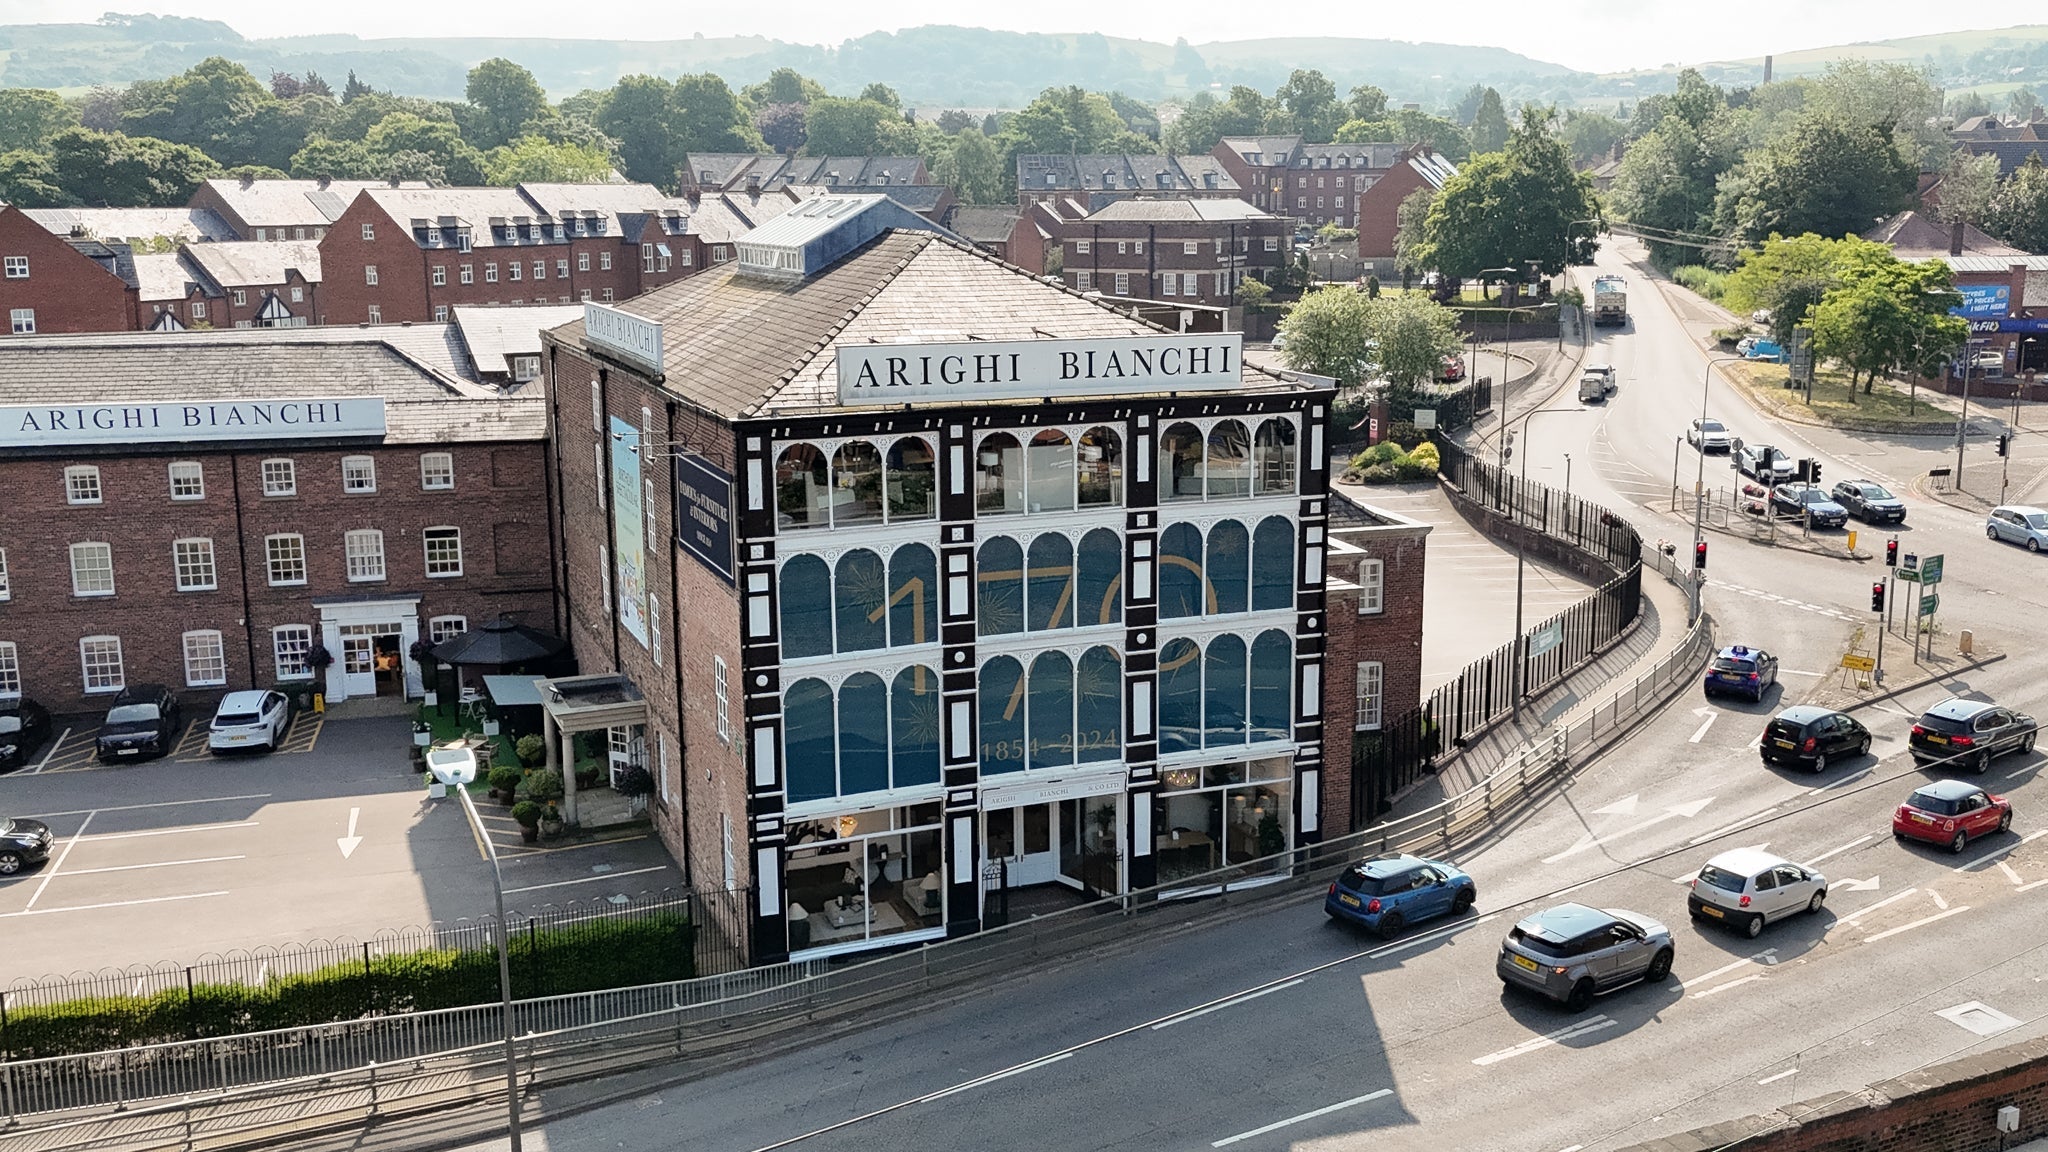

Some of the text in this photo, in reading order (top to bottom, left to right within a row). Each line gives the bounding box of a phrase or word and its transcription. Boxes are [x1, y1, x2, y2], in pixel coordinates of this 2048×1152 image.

[589, 310, 654, 353] ARIGHI BIANCHI
[854, 346, 1232, 388] ARIGHI BIANCHI
[19, 403, 343, 432] ARIGHI BIANCHI
[1039, 788, 1070, 798] BIANCHI
